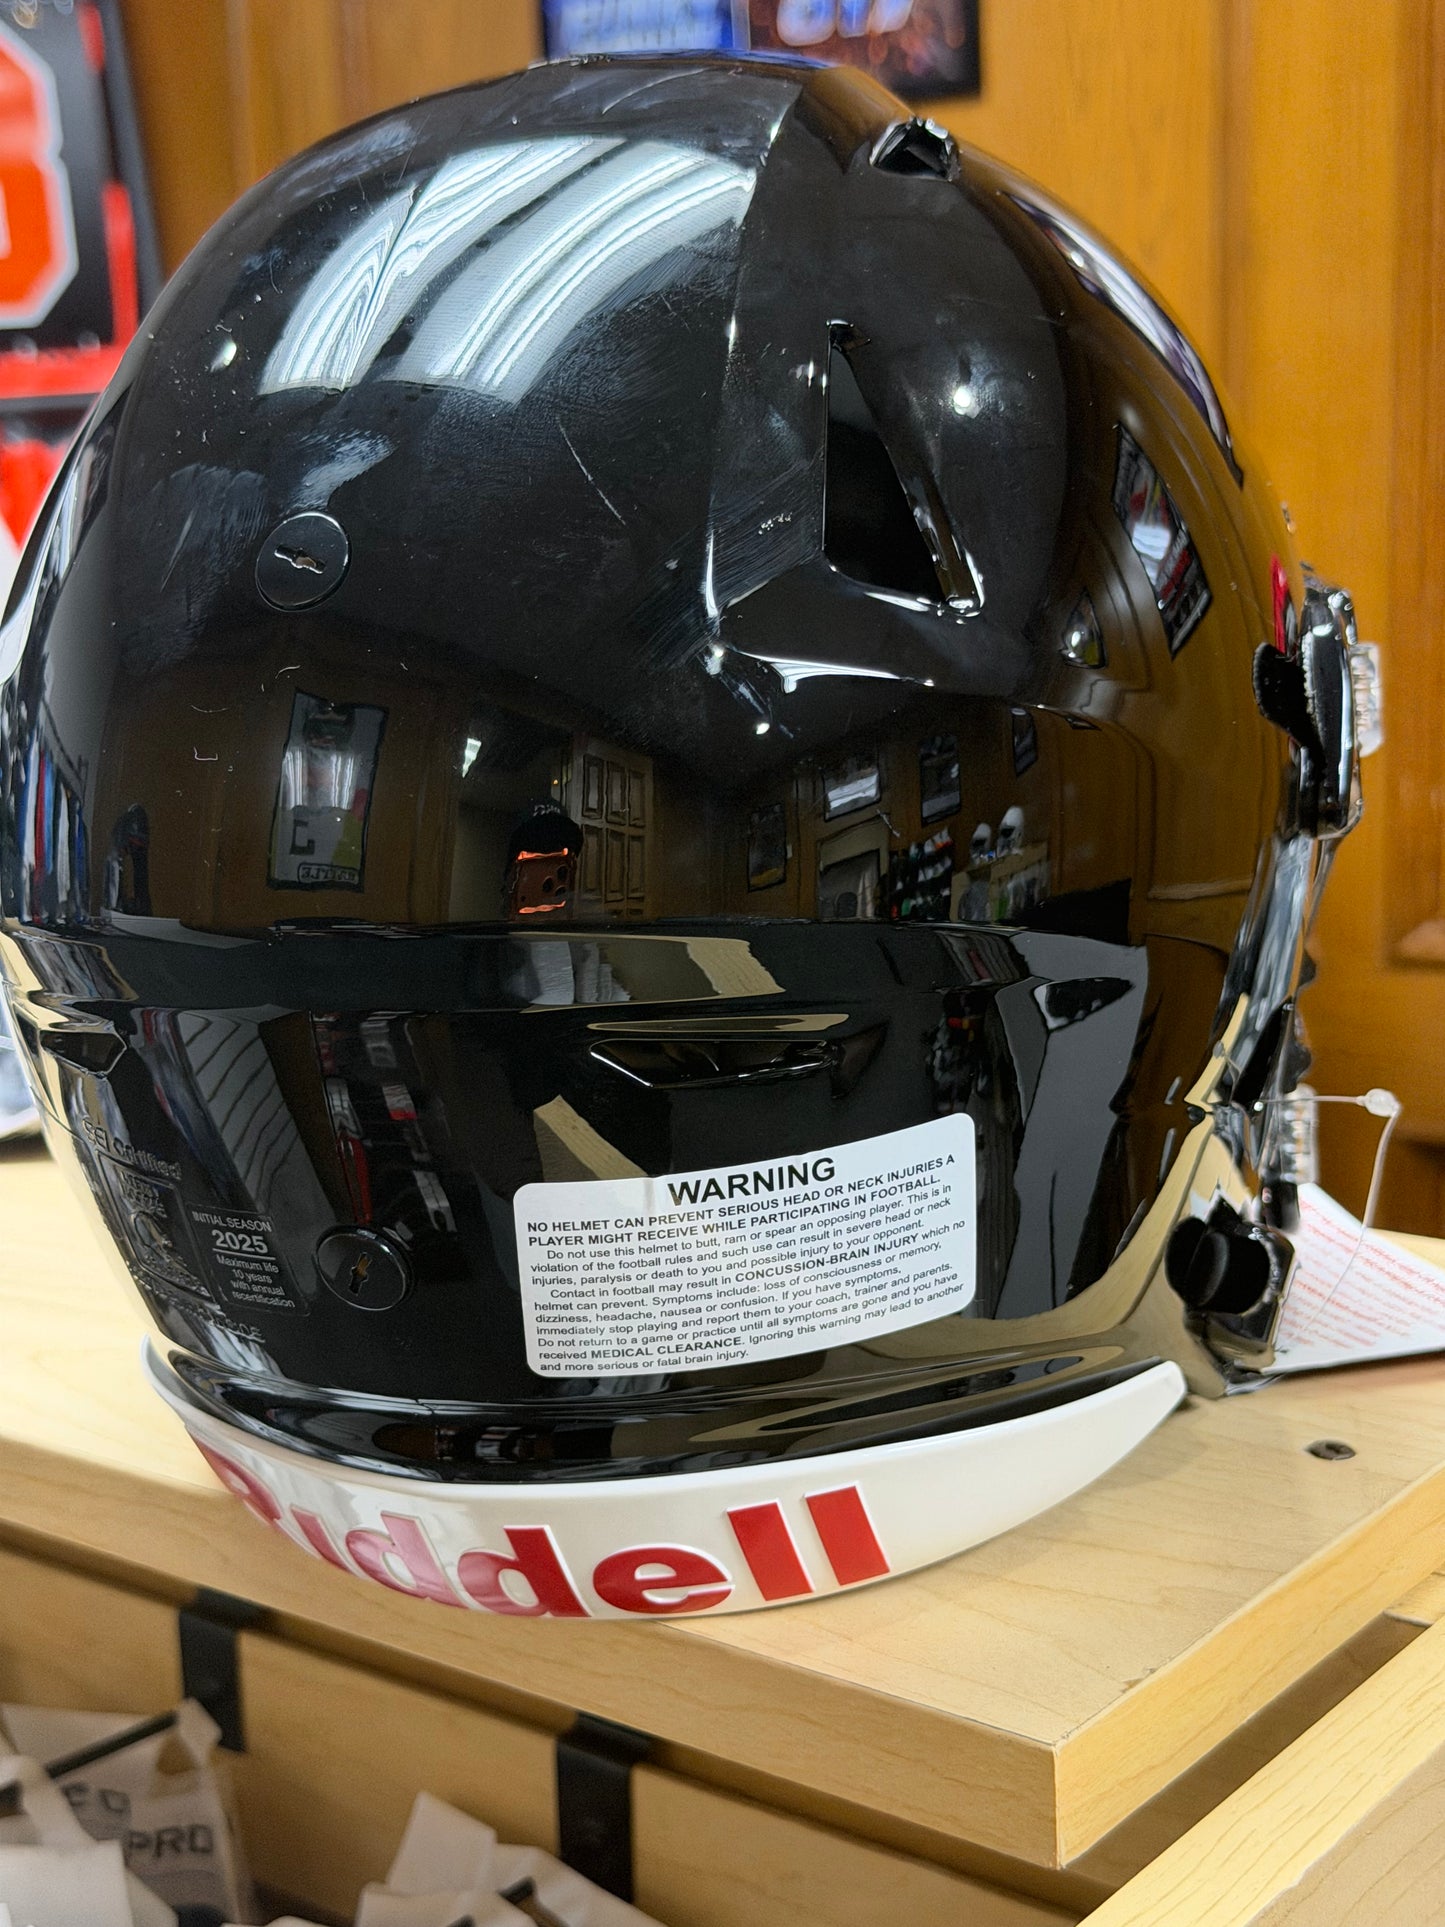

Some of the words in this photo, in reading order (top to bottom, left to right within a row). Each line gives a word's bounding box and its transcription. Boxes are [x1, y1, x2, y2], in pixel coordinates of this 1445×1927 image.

[527, 1221, 548, 1232] NO
[551, 1219, 610, 1232] HELMET
[614, 1216, 644, 1229] CAN
[648, 1208, 714, 1226] PREVENT
[718, 1198, 779, 1218] SERIOUS
[783, 1190, 821, 1207] HEAD
[824, 1184, 844, 1198] OR
[847, 1174, 884, 1193] NECK
[887, 1157, 943, 1183] INJURIES
[945, 1153, 955, 1165] A
[668, 1157, 835, 1206] WARNING
[192, 1211, 227, 1227] INITIAL
[227, 1217, 272, 1232] SEASON
[528, 1235, 584, 1246] PLAYER
[588, 1231, 633, 1245] MIGHT
[637, 1225, 698, 1242] RECEIVE
[701, 1218, 746, 1234] WHILE
[750, 1197, 850, 1227] PARTICIPATING
[854, 1193, 867, 1206] IN
[870, 1174, 941, 1202] FOOTBALL.
[530, 1262, 579, 1272] violation
[582, 1261, 594, 1271] of
[596, 1261, 615, 1271] the
[618, 1256, 661, 1269] football
[664, 1254, 693, 1265] rules
[696, 1249, 718, 1262] and
[721, 1245, 749, 1258] such
[752, 1243, 773, 1253] use
[775, 1238, 796, 1249] can
[799, 1230, 830, 1245] result
[832, 1227, 843, 1237] in
[846, 1218, 882, 1234] severe
[884, 1208, 911, 1224] head
[913, 1206, 925, 1216] or
[927, 1197, 951, 1212] neck
[546, 1249, 564, 1259] Do
[567, 1249, 586, 1259] not
[589, 1249, 610, 1258] use
[614, 1246, 635, 1256] this
[638, 1242, 678, 1255] helmet
[681, 1241, 692, 1250] to
[695, 1237, 721, 1249] butt,
[724, 1234, 746, 1245] ram
[749, 1231, 762, 1240] or
[765, 1225, 797, 1239] spear
[799, 1222, 814, 1231] an
[816, 1209, 866, 1229] opposing
[869, 1199, 904, 1217] player.
[906, 1191, 929, 1204] This
[931, 1187, 940, 1197] is
[942, 1184, 951, 1194] in
[212, 1229, 268, 1254] 2025
[216, 1254, 263, 1271] Maximum
[262, 1262, 279, 1273] life
[531, 1275, 576, 1287] injuries,
[580, 1272, 632, 1286] paralysis
[635, 1272, 648, 1281] or
[650, 1267, 684, 1280] death
[686, 1266, 698, 1276] to
[701, 1264, 722, 1276] you
[725, 1258, 747, 1270] and
[750, 1250, 797, 1269] possible
[800, 1244, 830, 1258] injury
[832, 1241, 843, 1250] to
[846, 1234, 870, 1250] your
[550, 1288, 596, 1298] Contact
[598, 1287, 609, 1297] in
[612, 1284, 655, 1296] football
[658, 1283, 683, 1293] may
[686, 1277, 718, 1289] result
[721, 1275, 731, 1285] in
[735, 1246, 870, 1282] CONCUSSION-BRAIN
[873, 1232, 919, 1254] INJURY
[921, 1224, 950, 1240] which
[952, 1220, 965, 1230] no
[230, 1280, 250, 1290] with
[252, 1283, 285, 1296] annual
[232, 1269, 244, 1279] 10
[245, 1272, 273, 1284] years
[534, 1301, 573, 1311] helmet
[576, 1302, 598, 1310] can
[601, 1298, 648, 1311] prevent.
[652, 1292, 713, 1307] Symptoms
[716, 1284, 760, 1298] include:
[763, 1280, 786, 1291] loss
[789, 1275, 800, 1286] of
[803, 1258, 882, 1283] consciousness
[885, 1254, 896, 1264] or
[535, 1313, 592, 1323] dizziness,
[660, 1306, 702, 1317] nausea
[705, 1304, 717, 1312] or
[720, 1295, 778, 1310] confusion.
[782, 1290, 789, 1300] If
[791, 1288, 812, 1300] you
[815, 1281, 841, 1294] have
[536, 1325, 605, 1336] immediately
[609, 1324, 634, 1334] stop
[637, 1320, 678, 1334] playing
[681, 1316, 703, 1328] and
[706, 1312, 740, 1325] report
[742, 1308, 771, 1319] them
[774, 1305, 785, 1314] to
[788, 1300, 813, 1314] your
[815, 1291, 851, 1306] coach,
[854, 1281, 888, 1297] trainer
[890, 1274, 910, 1287] and
[537, 1337, 554, 1347] Do
[557, 1338, 576, 1347] not
[578, 1338, 612, 1347] return
[616, 1337, 627, 1345] to
[641, 1334, 673, 1346] game
[676, 1332, 689, 1340] or
[692, 1326, 736, 1341] practice
[739, 1320, 763, 1332] until
[766, 1317, 779, 1328] all
[782, 1307, 838, 1326] symptoms
[841, 1302, 858, 1312] are
[861, 1294, 888, 1309] gone
[890, 1286, 910, 1300] and
[912, 1281, 931, 1295] you
[934, 1272, 958, 1286] have
[539, 1350, 587, 1359] received
[590, 1347, 654, 1359] MEDICAL
[656, 1335, 745, 1355] CLEARANCE.
[749, 1329, 794, 1345] Ignoring
[797, 1324, 816, 1334] this
[819, 1314, 861, 1330] warning
[864, 1308, 887, 1319] may
[889, 1298, 911, 1312] lead
[914, 1297, 924, 1305] to
[926, 1283, 964, 1302] another
[540, 1362, 561, 1371] and
[564, 1363, 594, 1371] more
[597, 1360, 639, 1370] serious
[641, 1360, 654, 1368] or
[656, 1356, 681, 1367] fatal
[684, 1353, 713, 1364] brain
[716, 1349, 748, 1361] injury.
